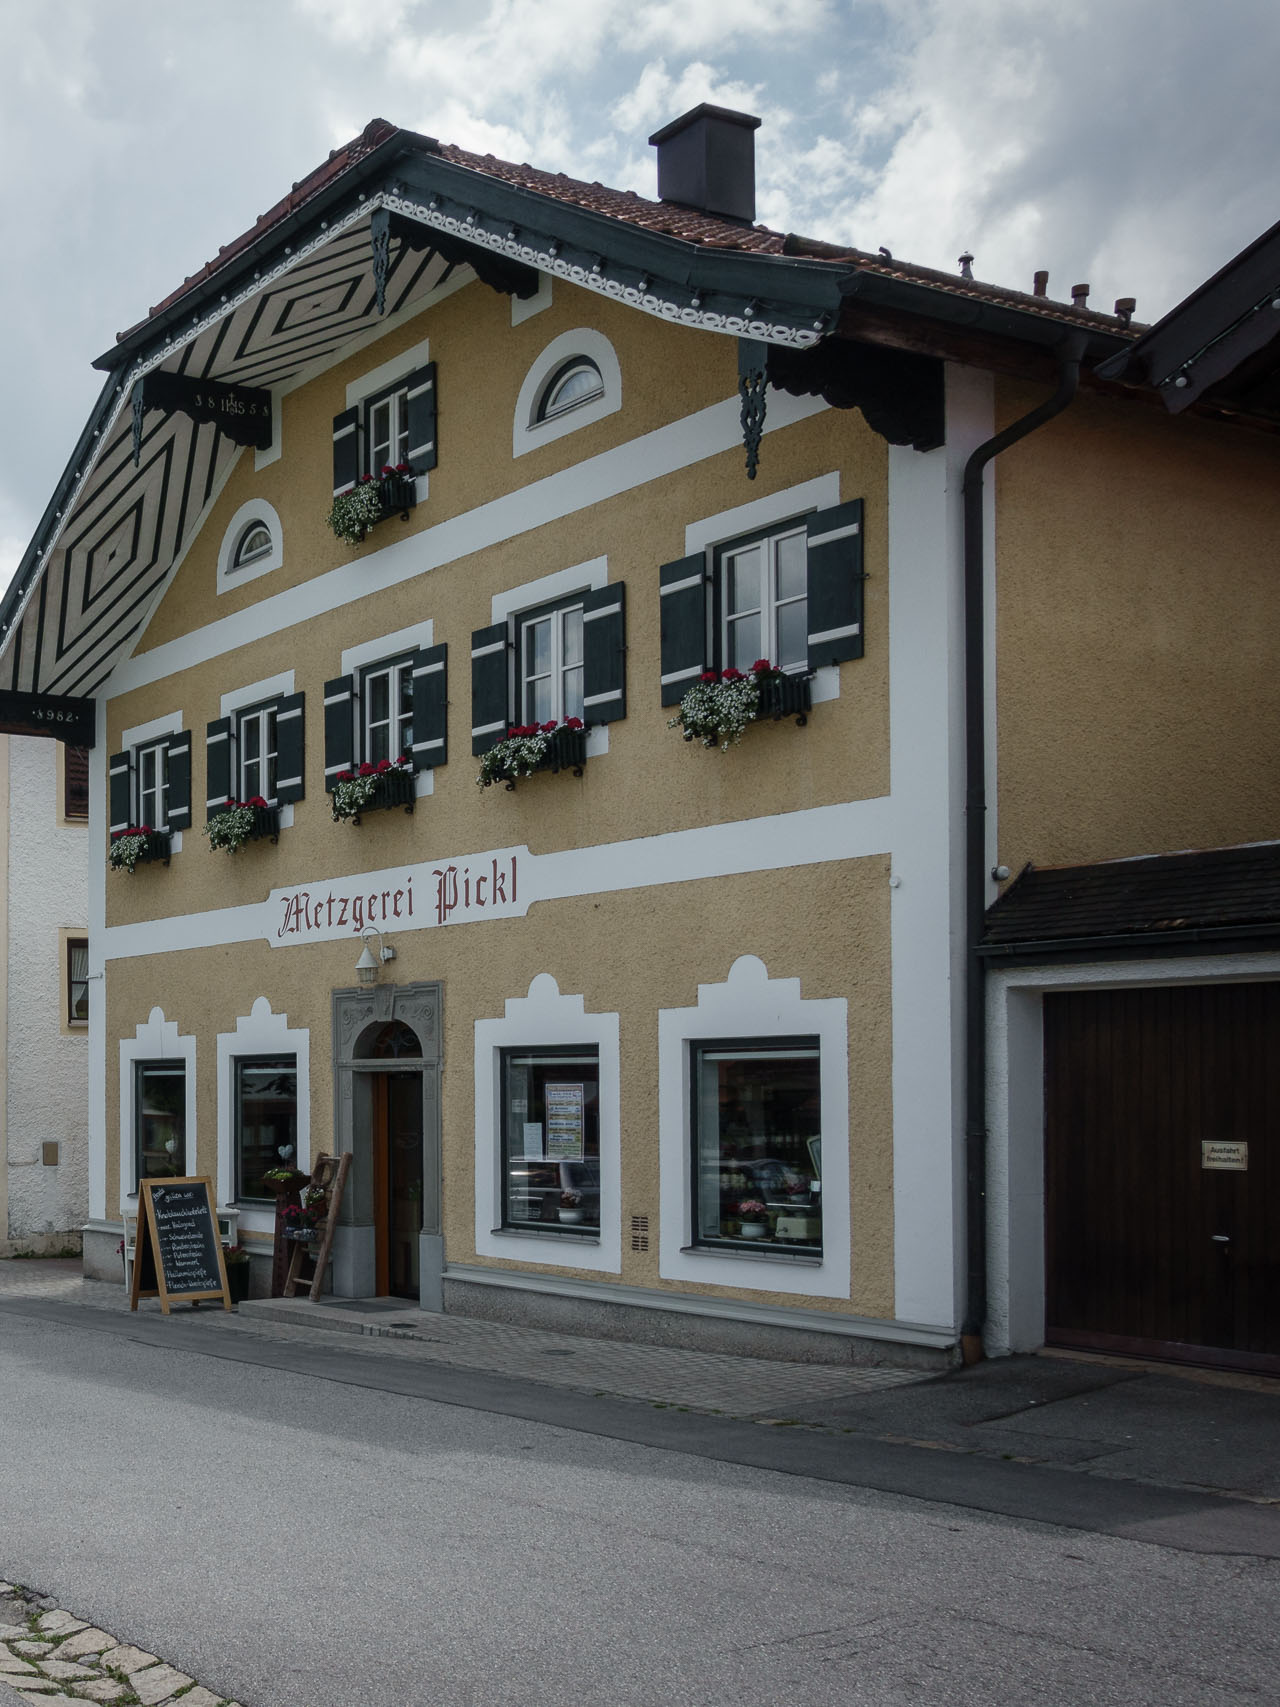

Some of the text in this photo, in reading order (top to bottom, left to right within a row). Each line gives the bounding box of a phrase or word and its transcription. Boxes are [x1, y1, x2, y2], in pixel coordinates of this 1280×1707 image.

[277, 855, 518, 938] Metzgerei Pickl
[1210, 1146, 1240, 1155] Ausfahrt
